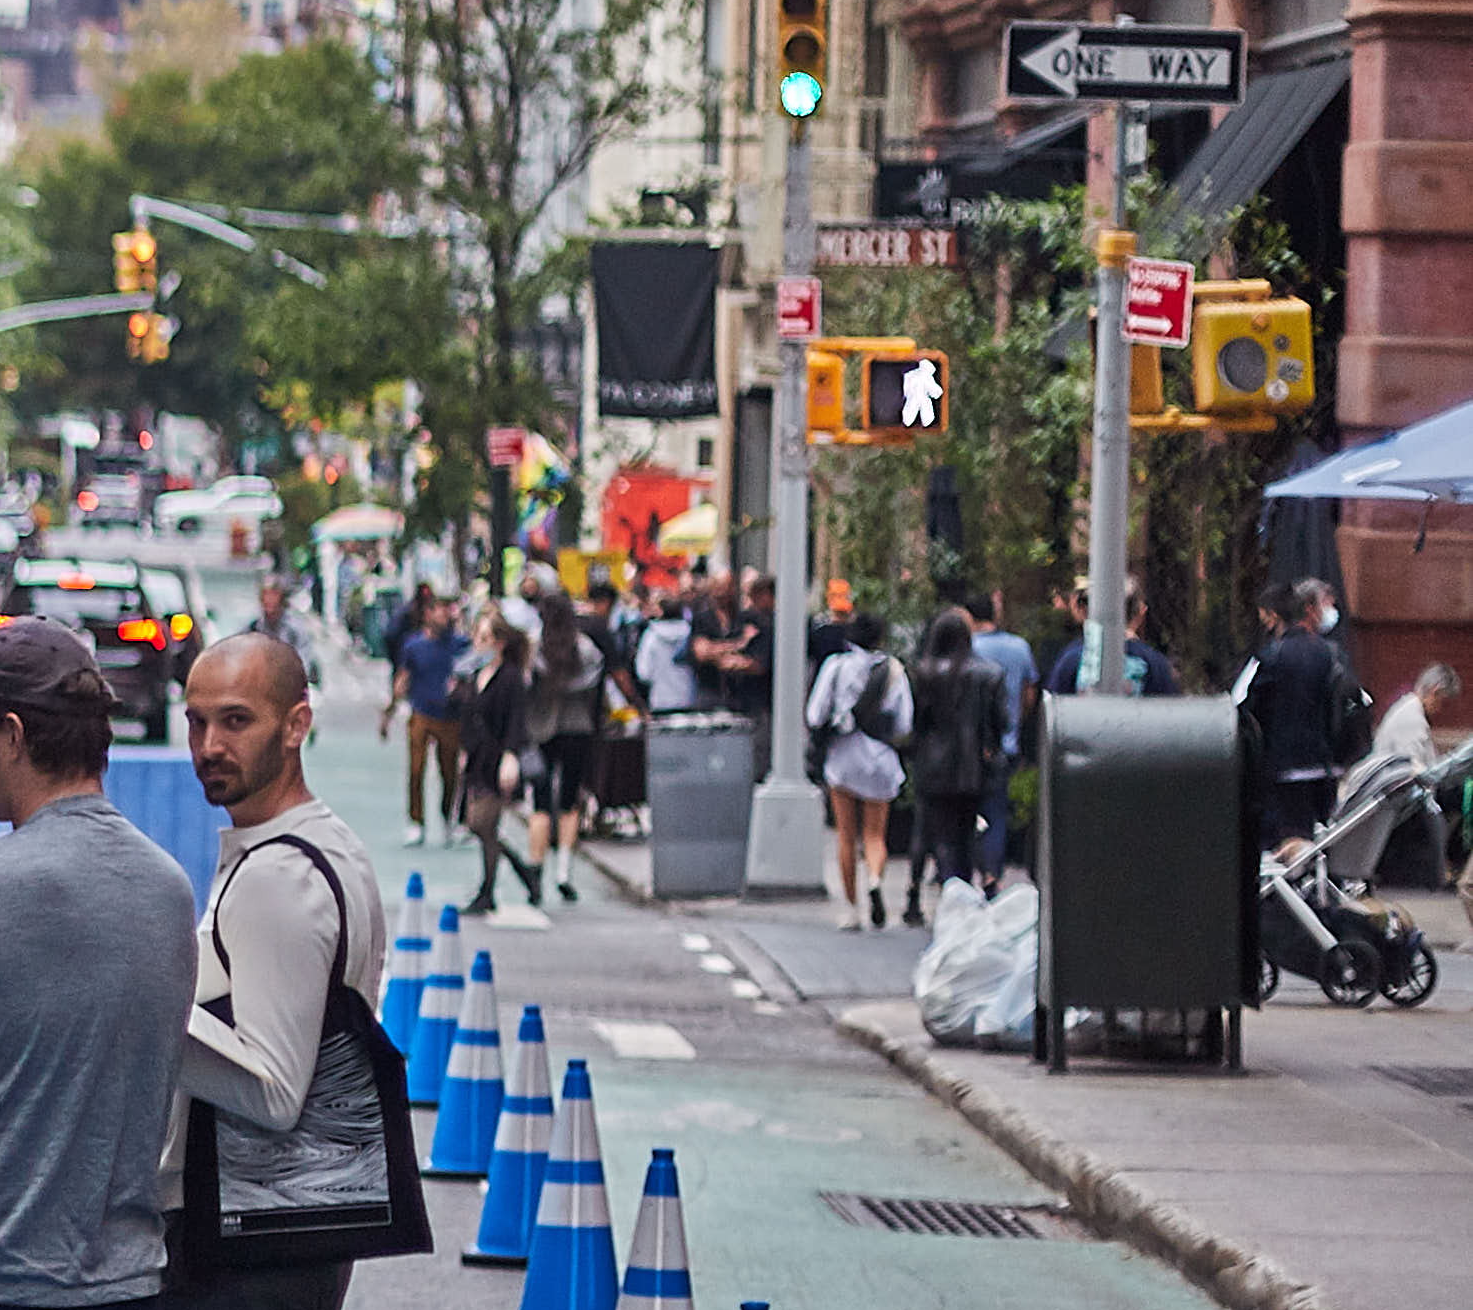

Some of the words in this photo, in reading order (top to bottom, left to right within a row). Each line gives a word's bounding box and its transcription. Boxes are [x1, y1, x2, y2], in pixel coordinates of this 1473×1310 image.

[1052, 48, 1115, 77] ONE
[1149, 50, 1216, 80] WAY
[817, 229, 911, 264] MERCER
[919, 230, 953, 264] ST
